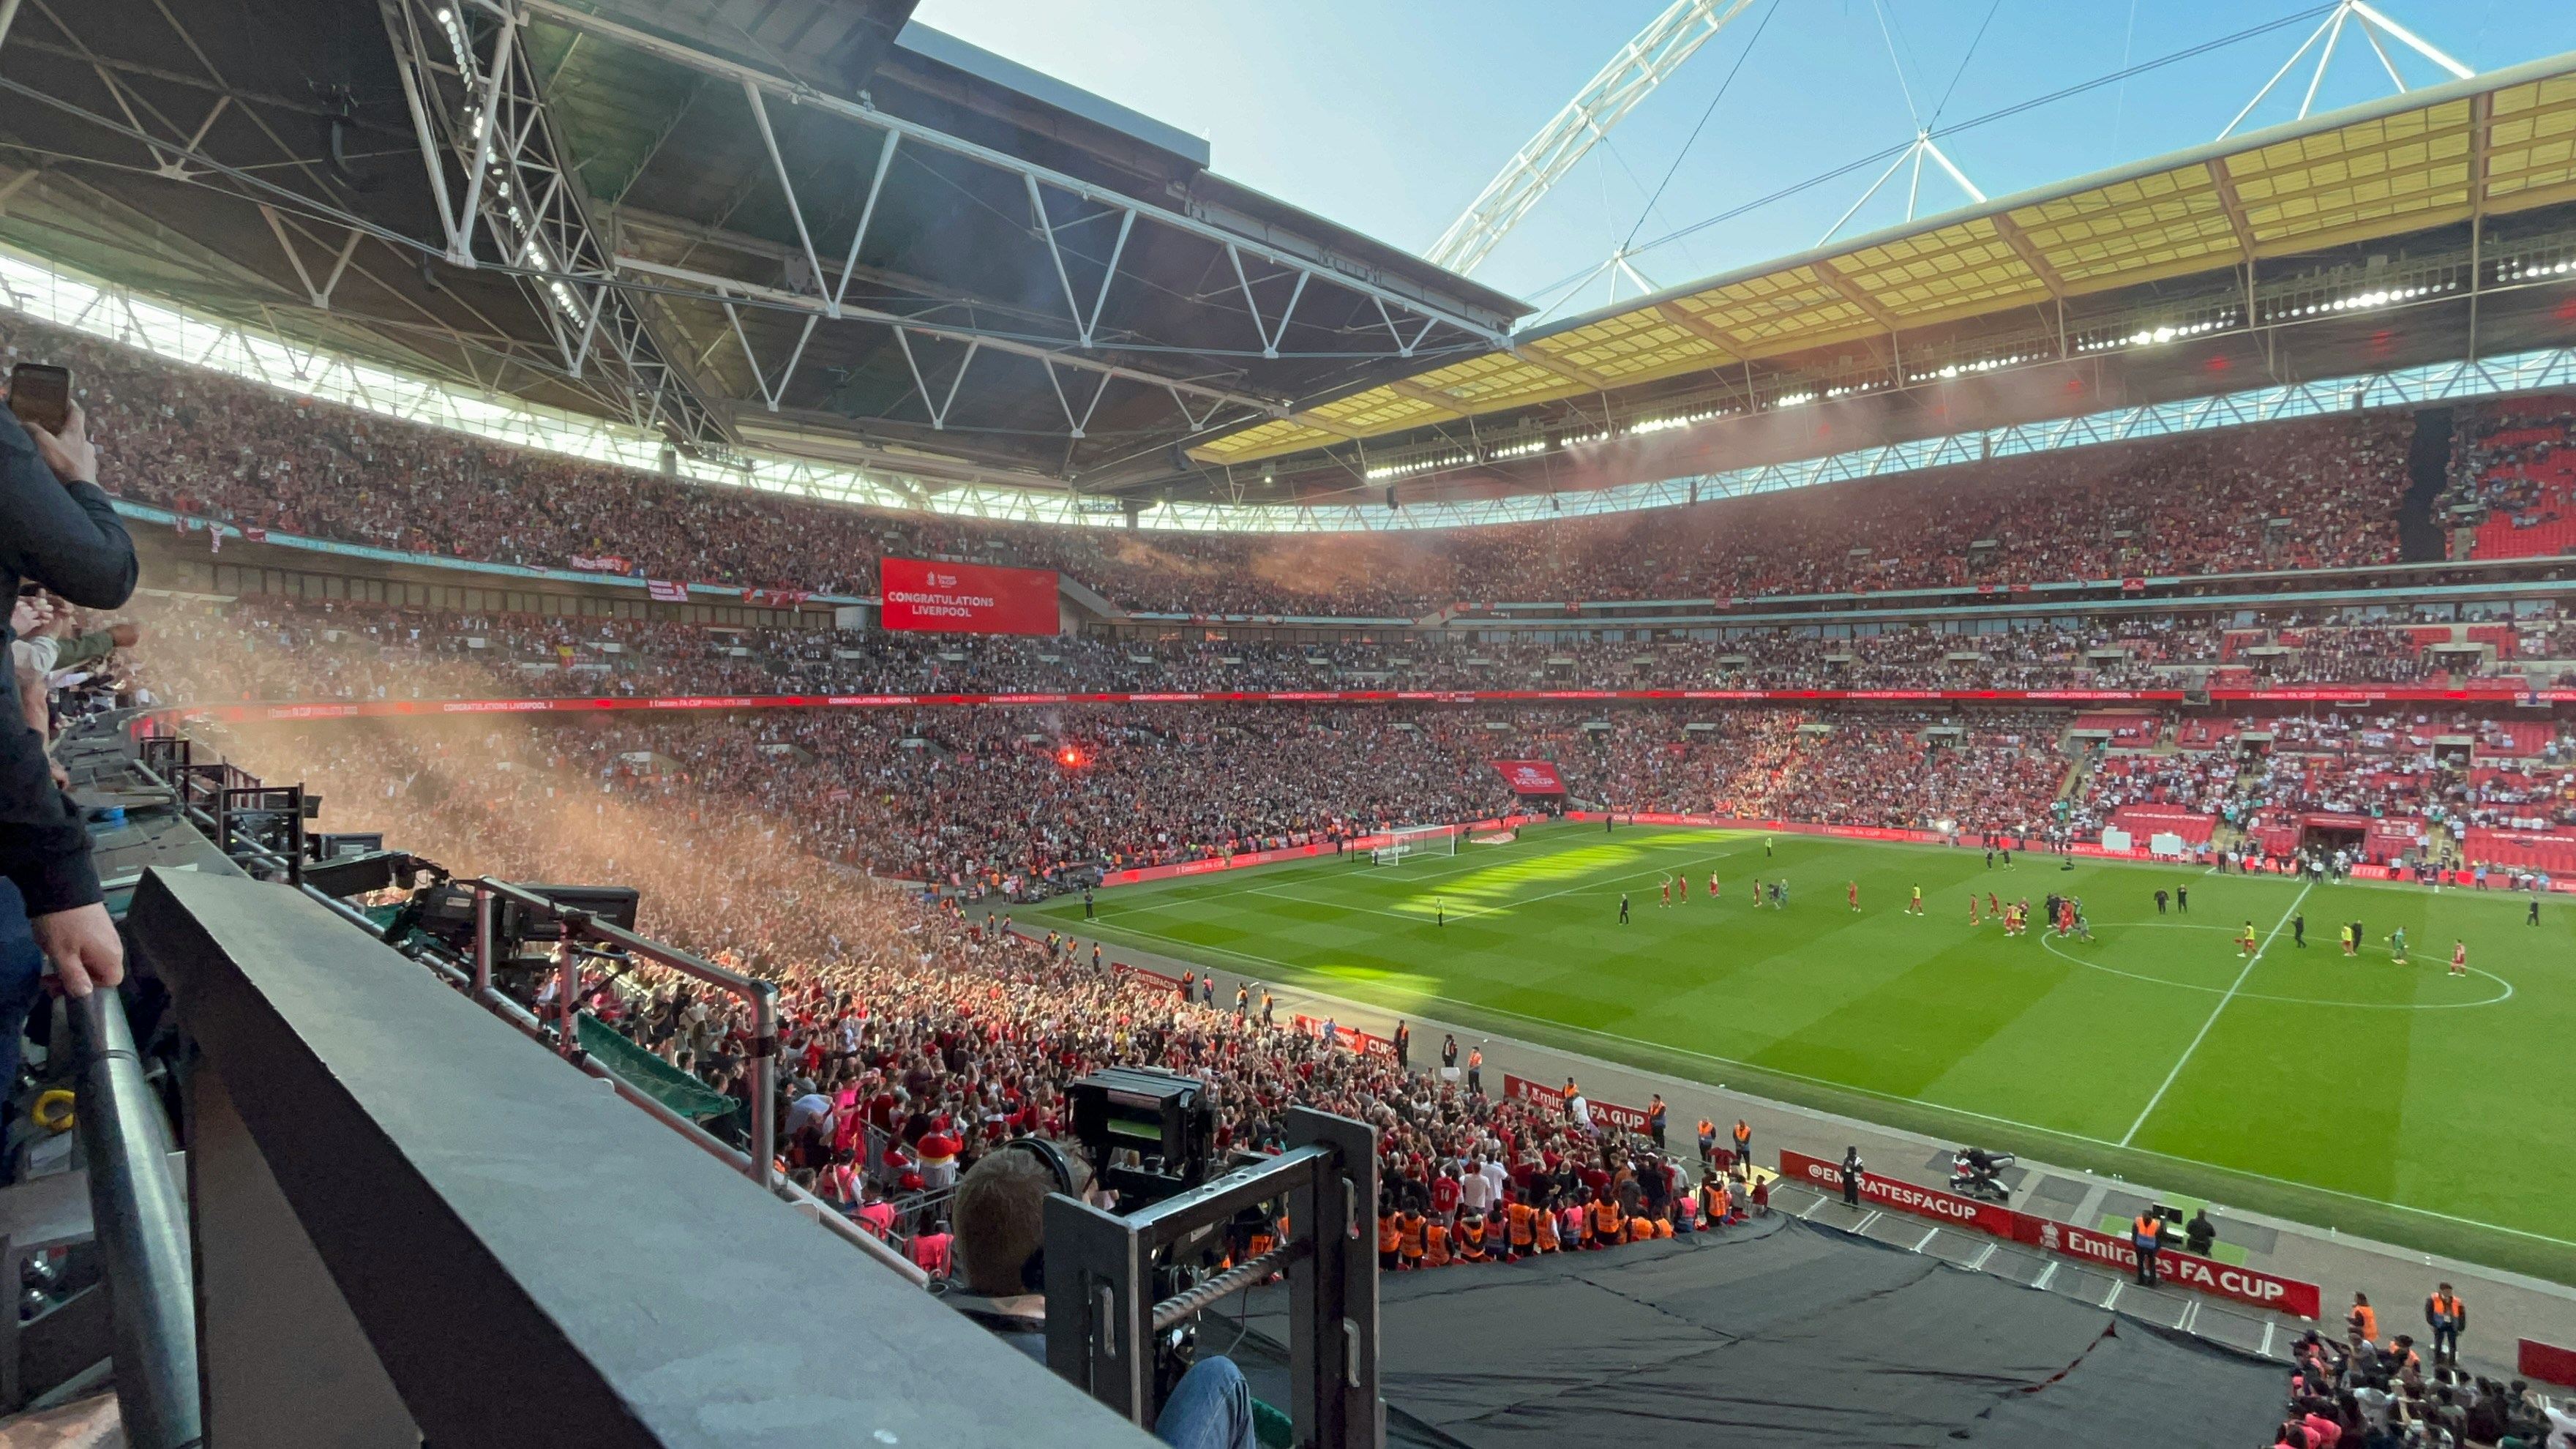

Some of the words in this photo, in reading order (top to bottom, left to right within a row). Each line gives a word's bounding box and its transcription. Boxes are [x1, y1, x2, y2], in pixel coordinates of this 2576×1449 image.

[888, 591, 994, 607] CONGRATULATIONS
[912, 604, 972, 617] LIVERPOOL
[443, 703, 508, 711] CONGRATULATIONS
[1613, 815, 1676, 823] CONRATULATIONS
[2124, 812, 2208, 820] CELEBRATING
[1589, 1104, 1609, 1121] FA
[1611, 1109, 1645, 1128] CUP
[1808, 1164, 1977, 1220] @EMRATESFACUP
[2068, 1231, 2173, 1275] Emiraes
[2179, 1260, 2216, 1287] FA
[2220, 1272, 2284, 1300] CUP
